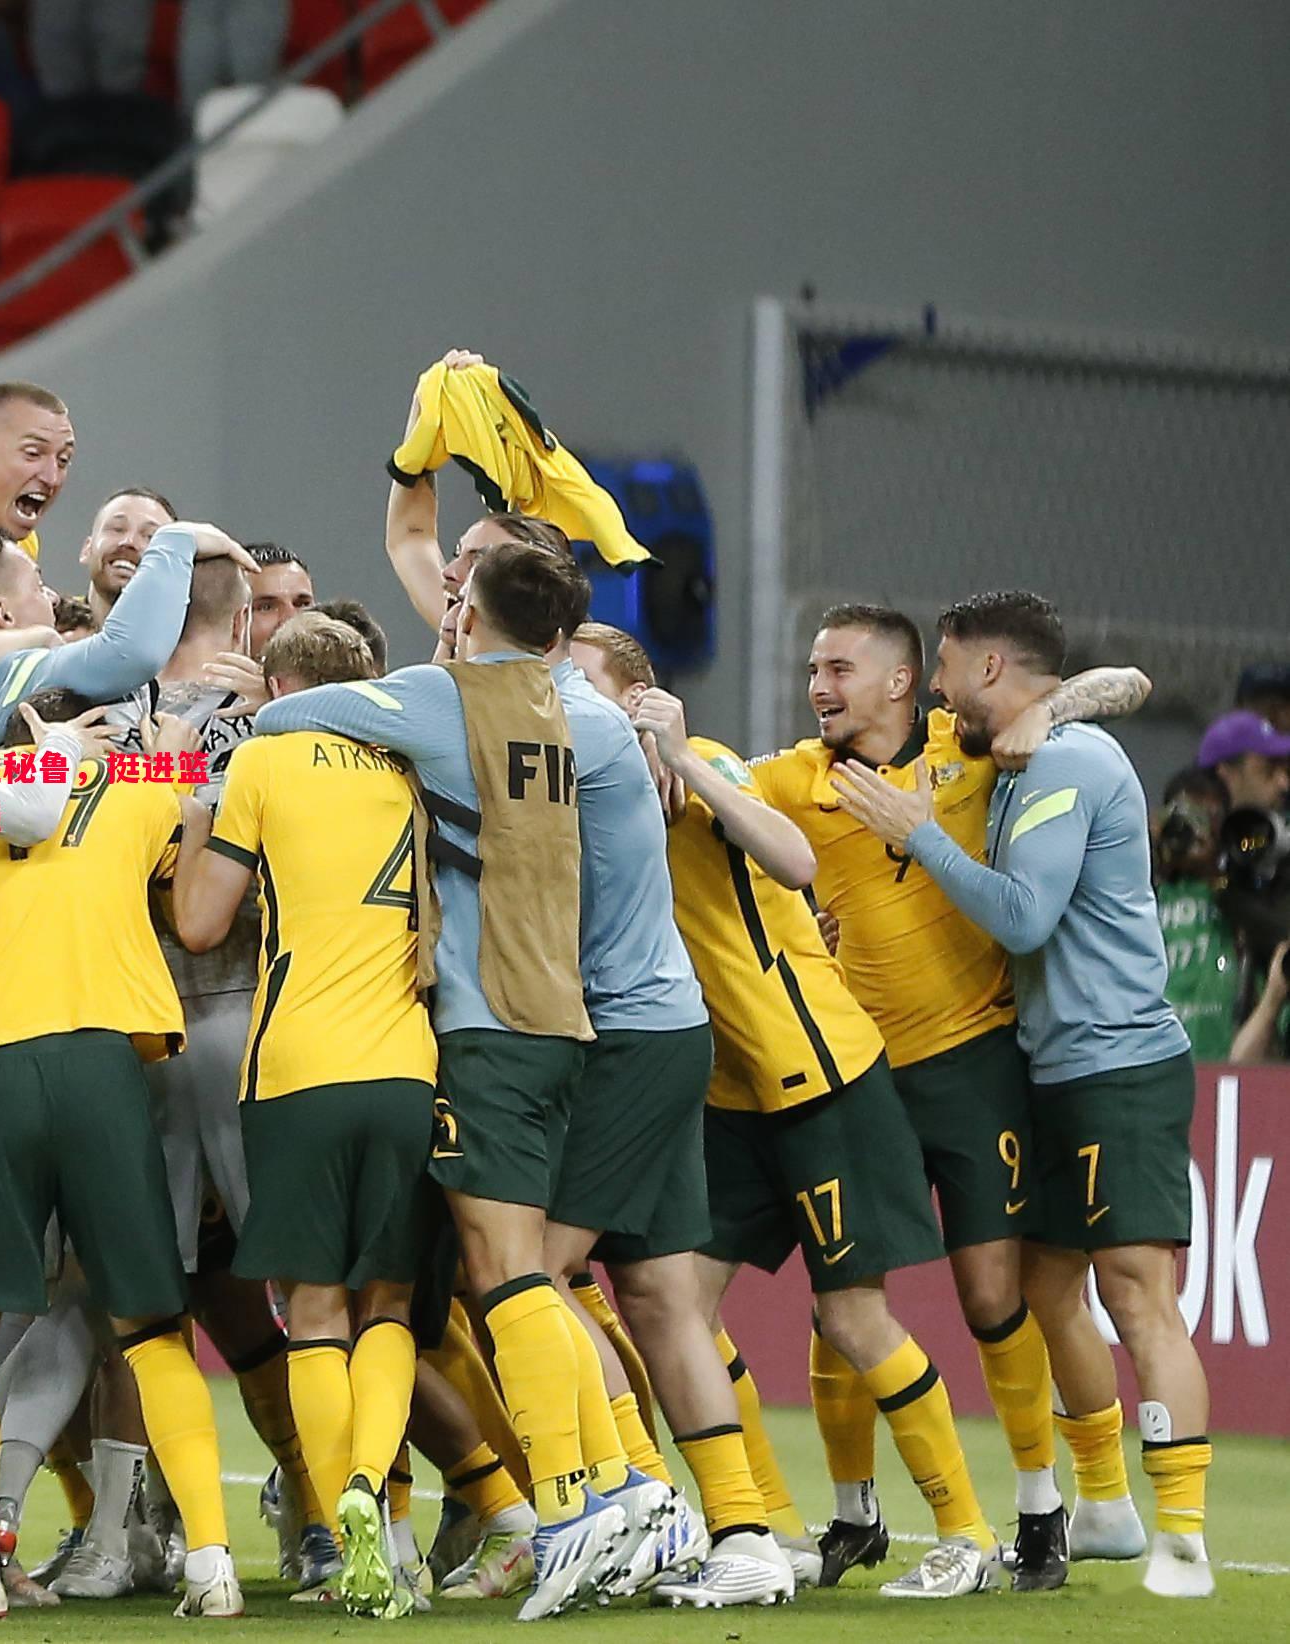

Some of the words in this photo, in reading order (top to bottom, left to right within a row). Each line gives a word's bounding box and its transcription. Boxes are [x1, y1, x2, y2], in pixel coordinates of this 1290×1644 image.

[362, 808, 419, 932] 4
[996, 1130, 1021, 1189] 9
[1077, 1143, 1100, 1206] 7
[796, 1178, 842, 1247] 17
